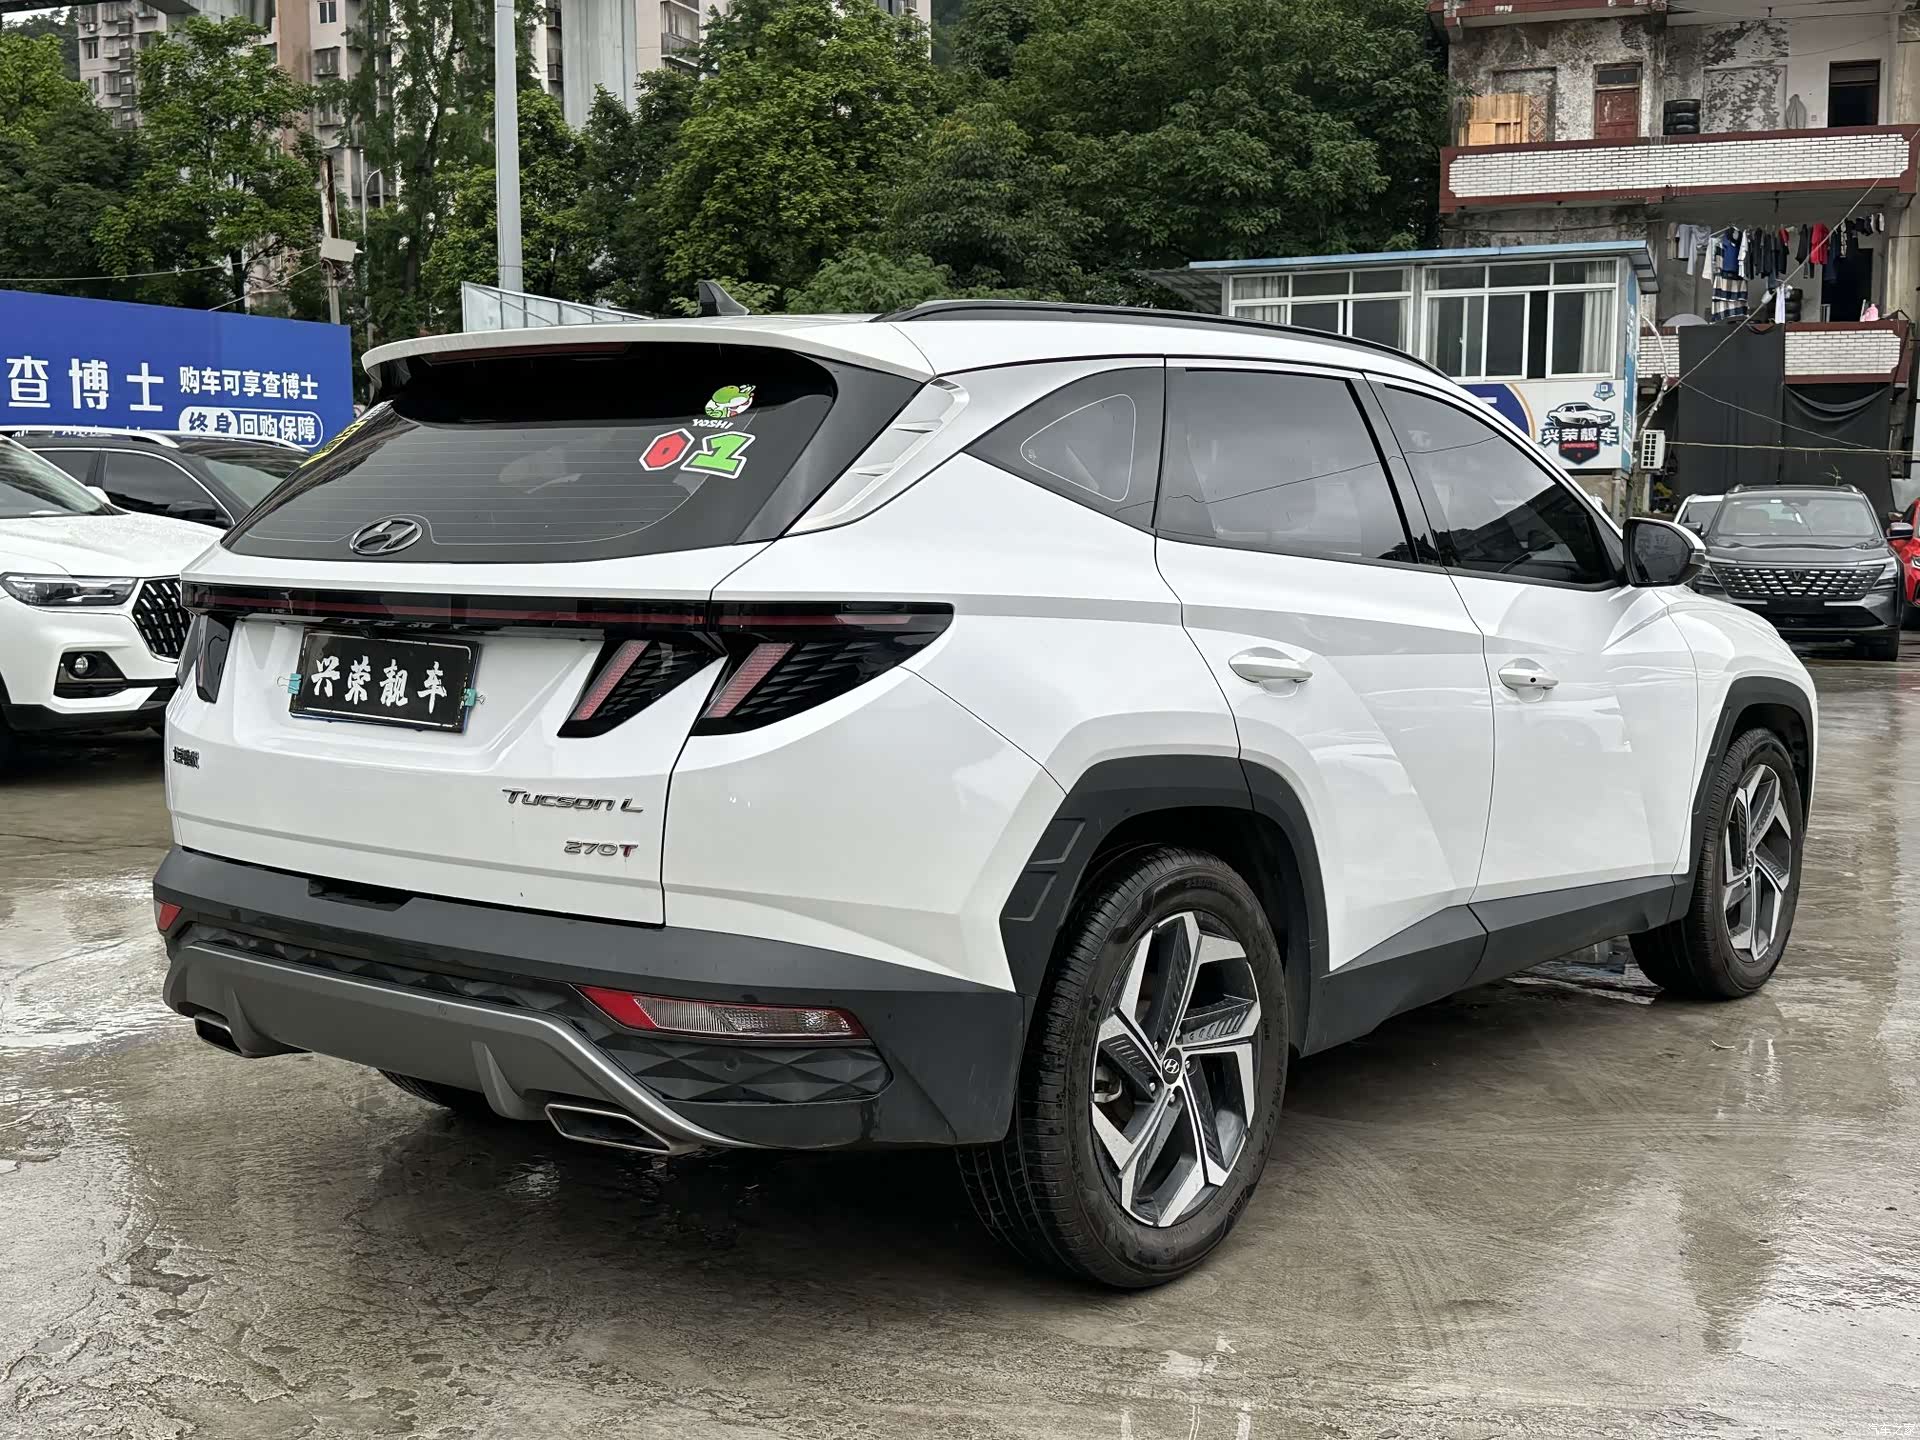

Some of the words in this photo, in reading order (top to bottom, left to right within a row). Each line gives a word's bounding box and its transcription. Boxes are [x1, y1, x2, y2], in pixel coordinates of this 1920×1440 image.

[6, 355, 165, 412] 查博士
[179, 366, 319, 400] 购车可享查博士
[692, 418, 734, 430] YOSHI
[1542, 426, 1618, 446] 兴荣靓车
[639, 428, 756, 479] 01
[311, 655, 447, 714] 兴荣靓车
[619, 797, 645, 813] L
[563, 840, 639, 858] 270T
